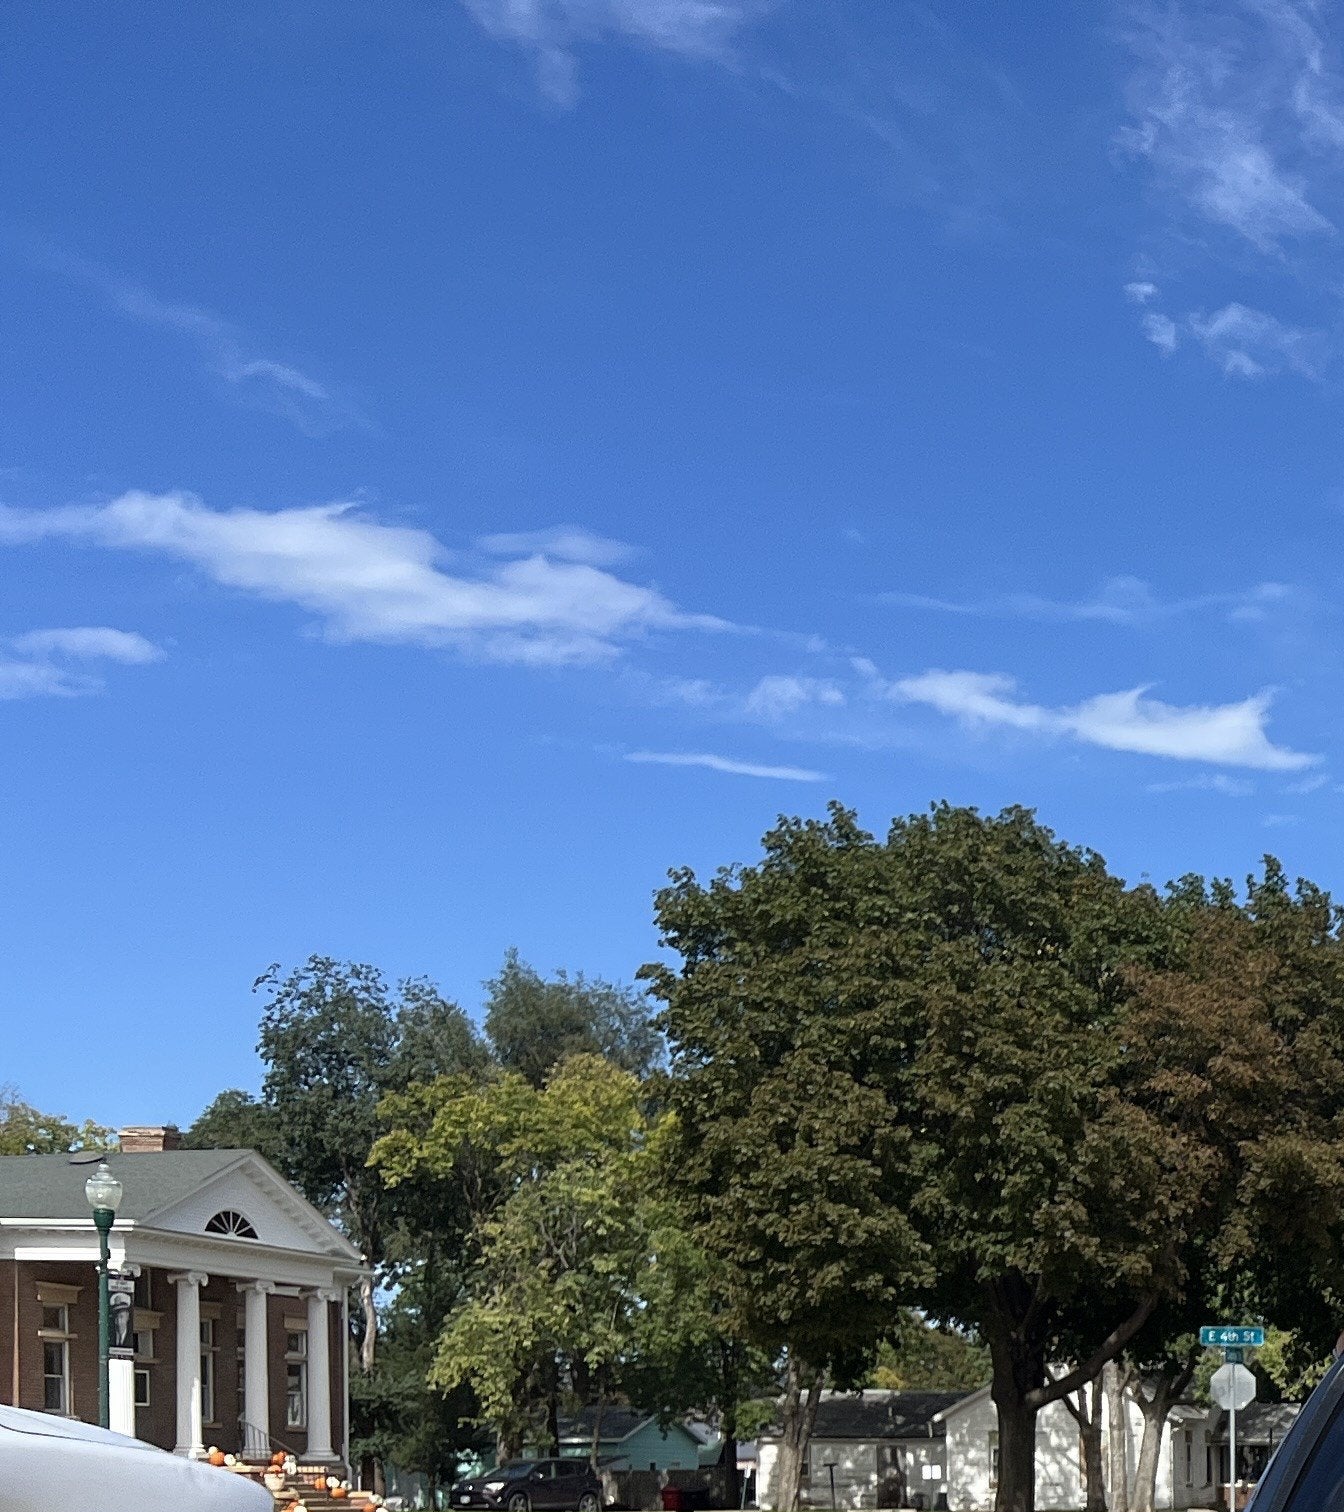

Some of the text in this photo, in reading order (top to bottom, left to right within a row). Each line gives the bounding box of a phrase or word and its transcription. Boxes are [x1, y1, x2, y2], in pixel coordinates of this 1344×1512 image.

[1208, 1331, 1256, 1341] E 4th St
